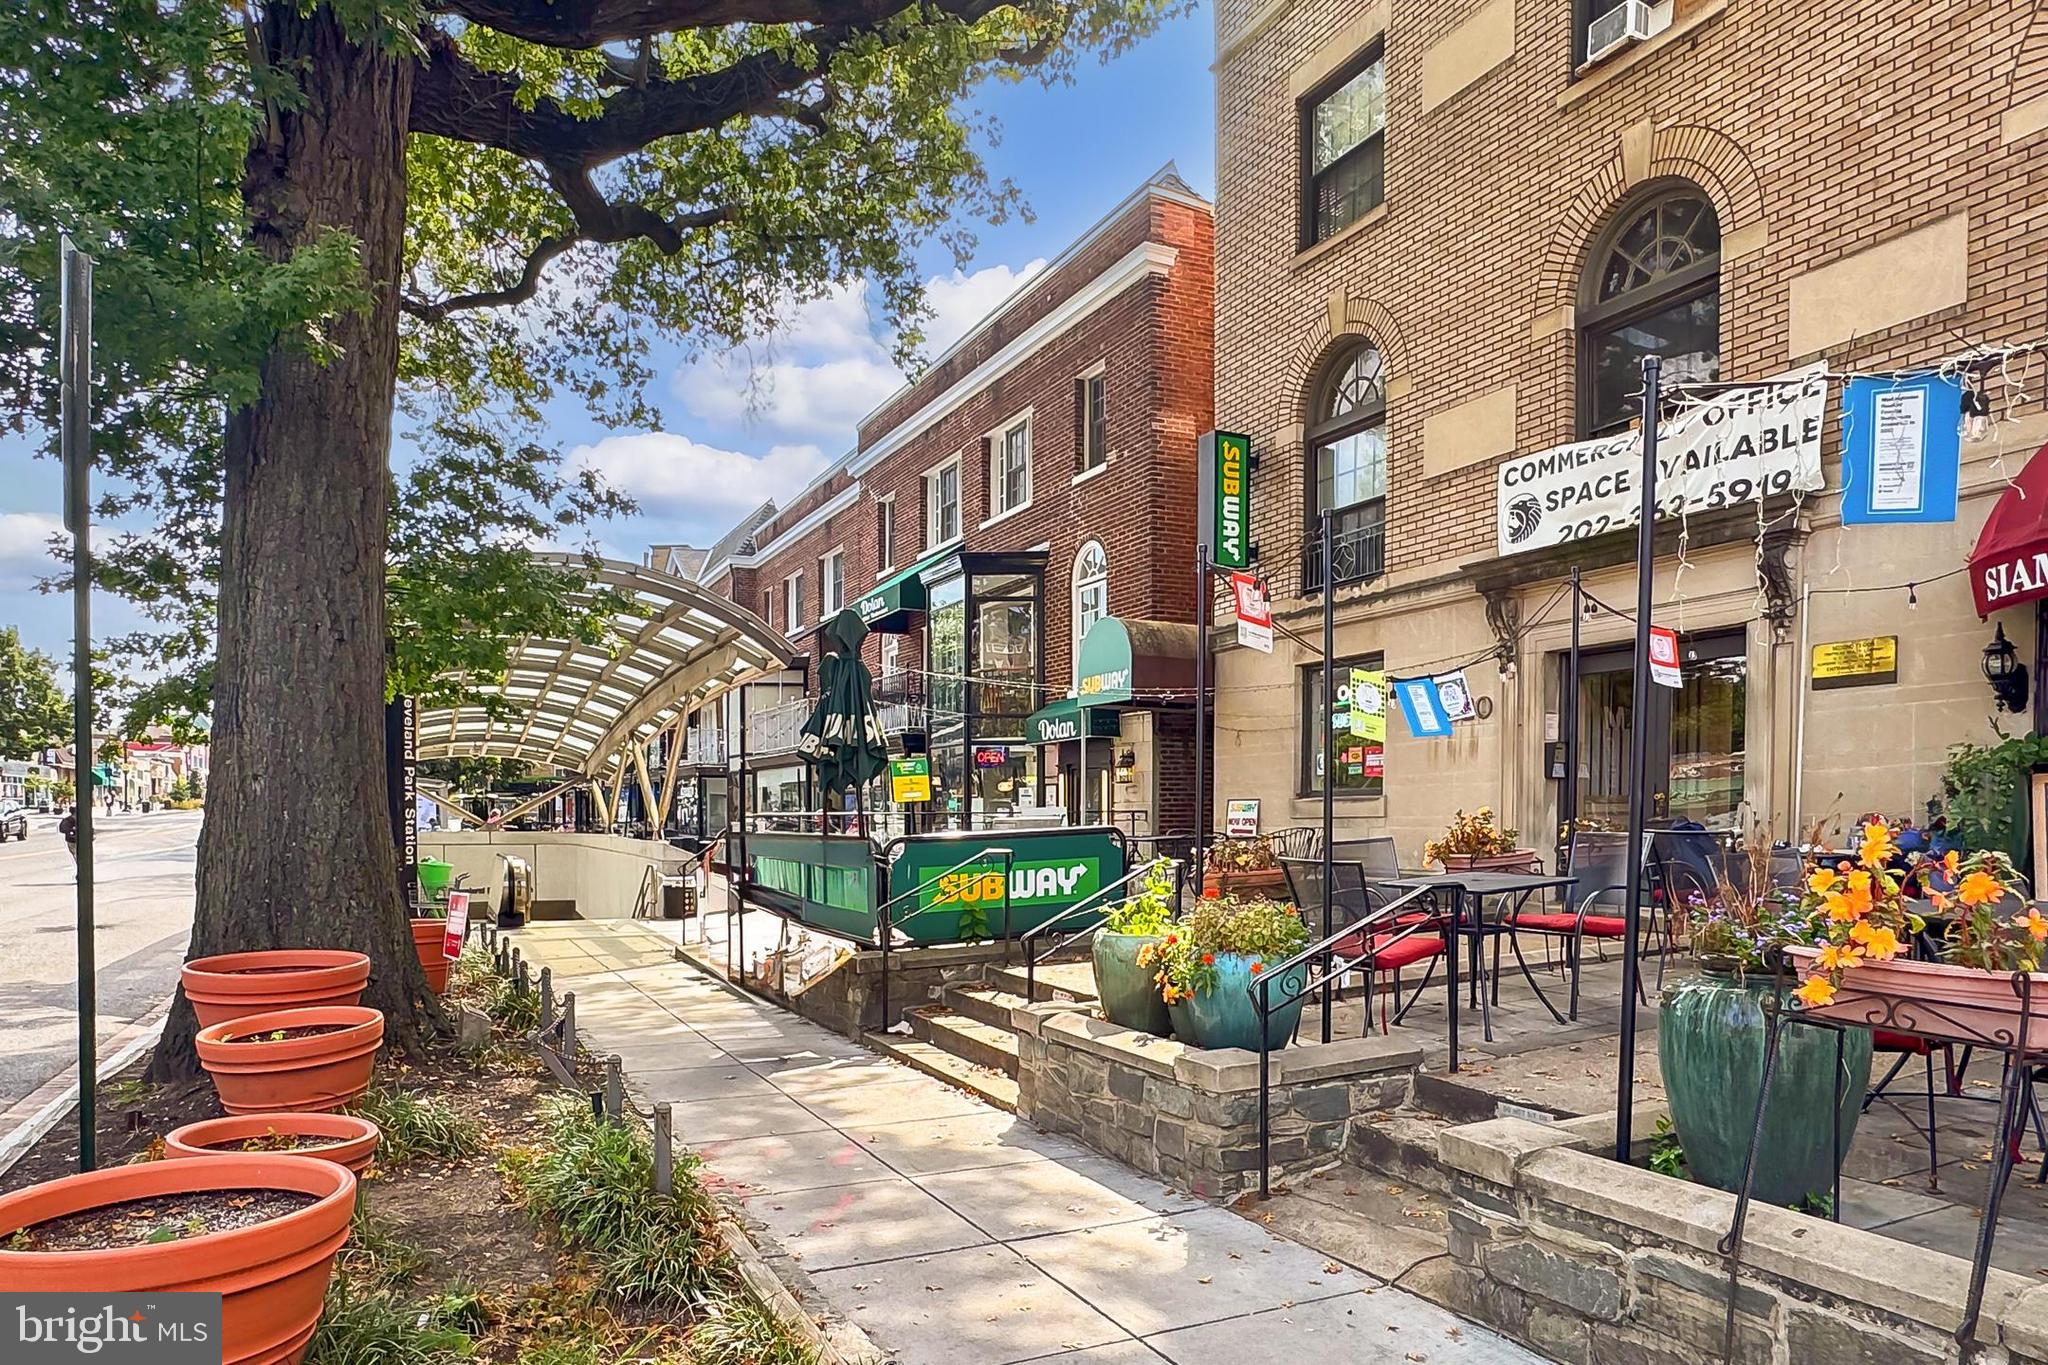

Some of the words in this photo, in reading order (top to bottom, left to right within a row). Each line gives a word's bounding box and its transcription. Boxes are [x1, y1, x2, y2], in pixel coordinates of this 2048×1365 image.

[1546, 469, 1631, 512] SPACE
[1640, 415, 1820, 488] VAILABLE
[1222, 440, 1240, 562] SUBWAY
[1080, 668, 1129, 696] SUBWAY
[1038, 717, 1077, 740] Dolan
[977, 752, 1005, 764] OPEN
[404, 766, 415, 801] Park
[405, 808, 416, 865] Station
[933, 863, 1088, 906] SUBWAY
